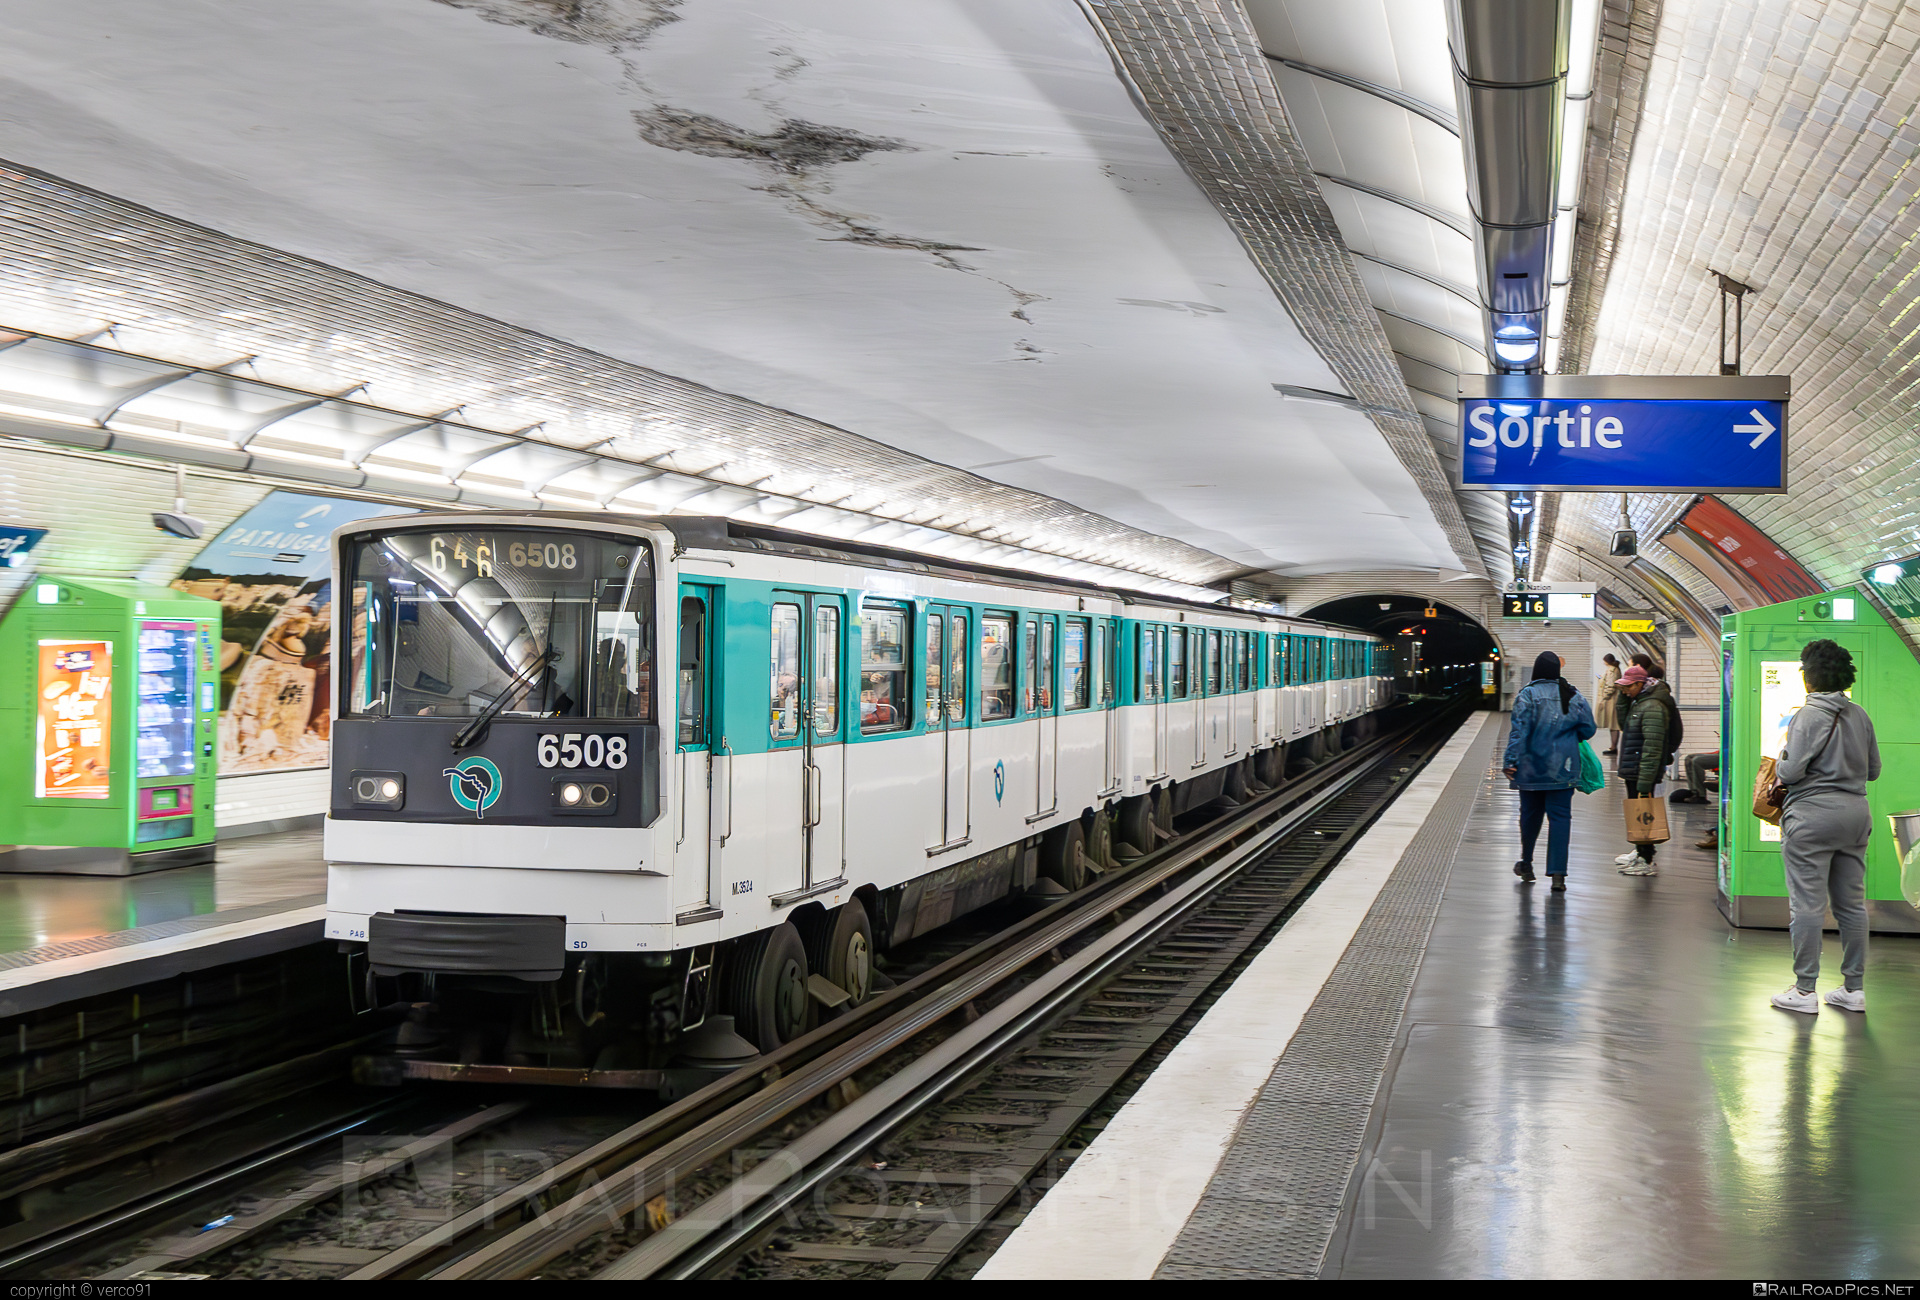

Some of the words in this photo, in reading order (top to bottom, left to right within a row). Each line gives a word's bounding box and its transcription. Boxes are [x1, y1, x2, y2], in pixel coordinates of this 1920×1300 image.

[1468, 405, 1624, 449] Sortie
[509, 542, 577, 570] 6508
[1512, 600, 1522, 613] 2
[1533, 600, 1544, 613] 6
[1616, 622, 1643, 630] Alarme
[537, 733, 628, 770] 6508
[573, 941, 588, 949] SD
